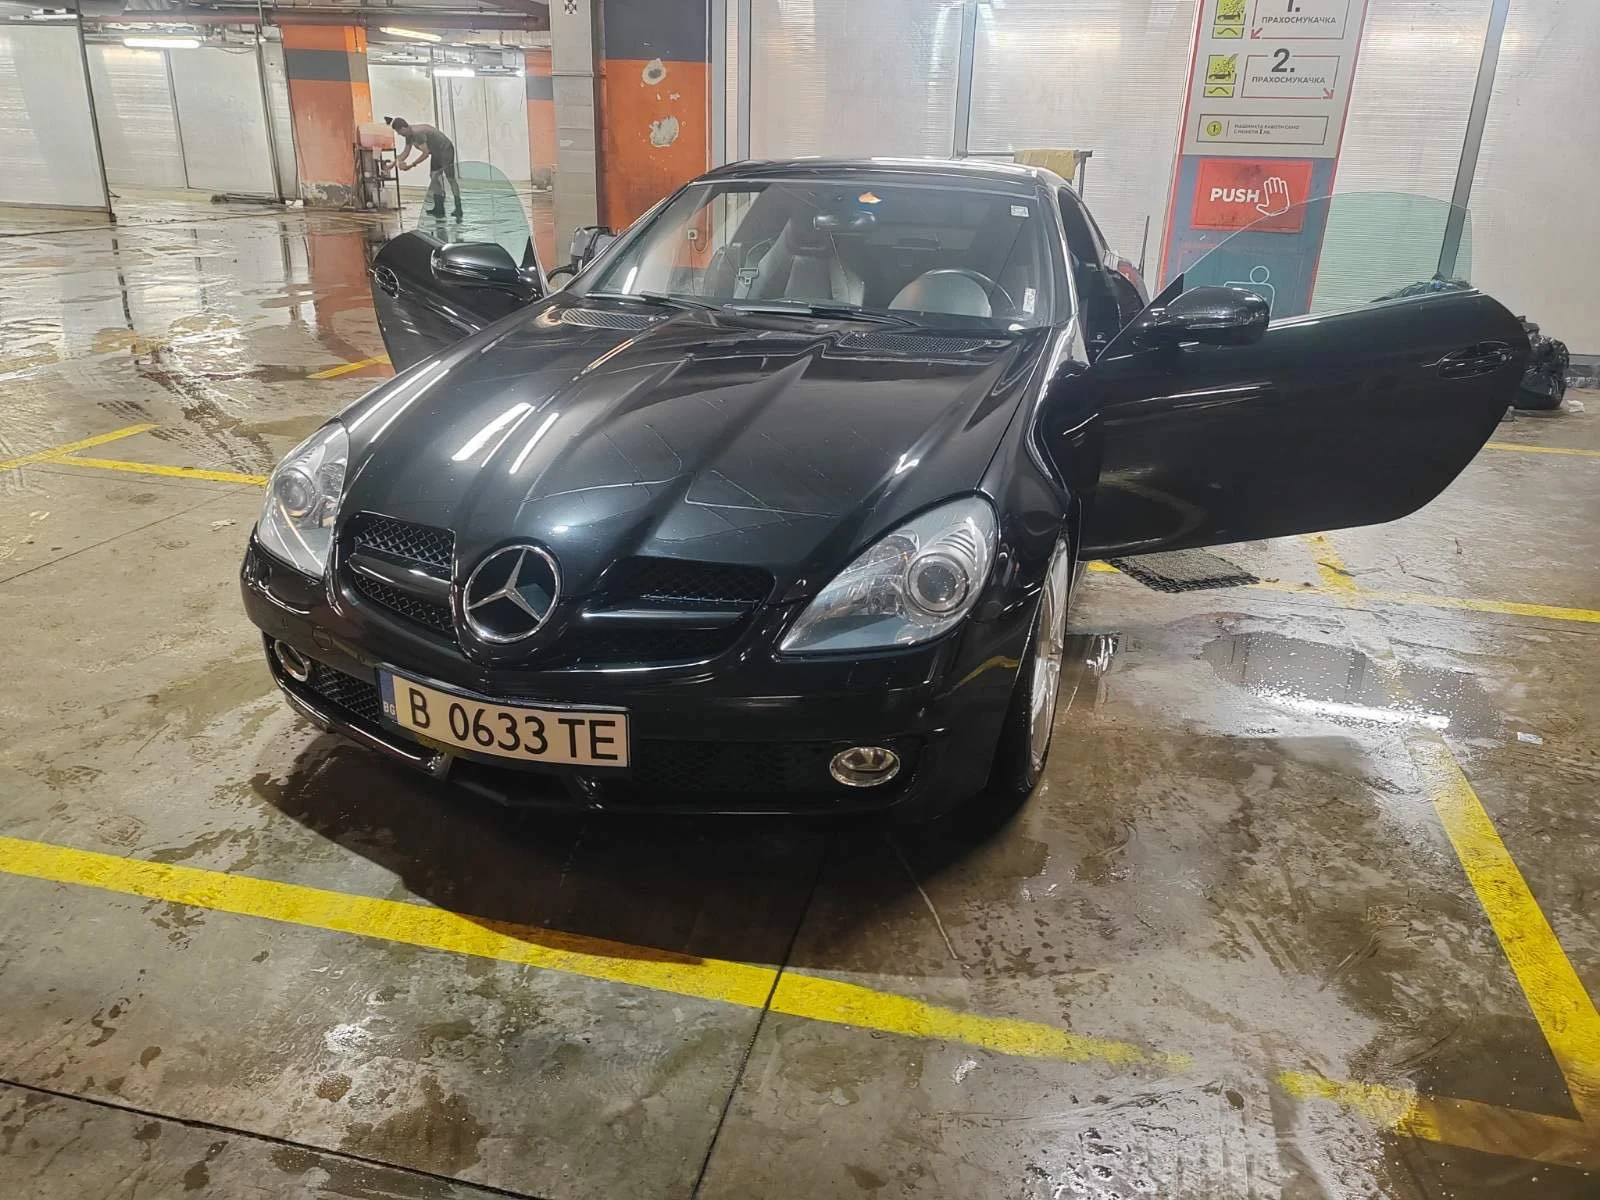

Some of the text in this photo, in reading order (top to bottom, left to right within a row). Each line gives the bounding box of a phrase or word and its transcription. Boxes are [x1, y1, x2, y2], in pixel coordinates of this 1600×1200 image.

[1261, 16, 1336, 24] ПРАХОСМУКАЧКА
[1271, 48, 1295, 73] 2.
[1251, 76, 1326, 84] ПРАХОСМУКАЧКА
[1210, 187, 1260, 203] PUSH
[383, 701, 396, 716] BG
[409, 688, 618, 761] B 0633 TE
